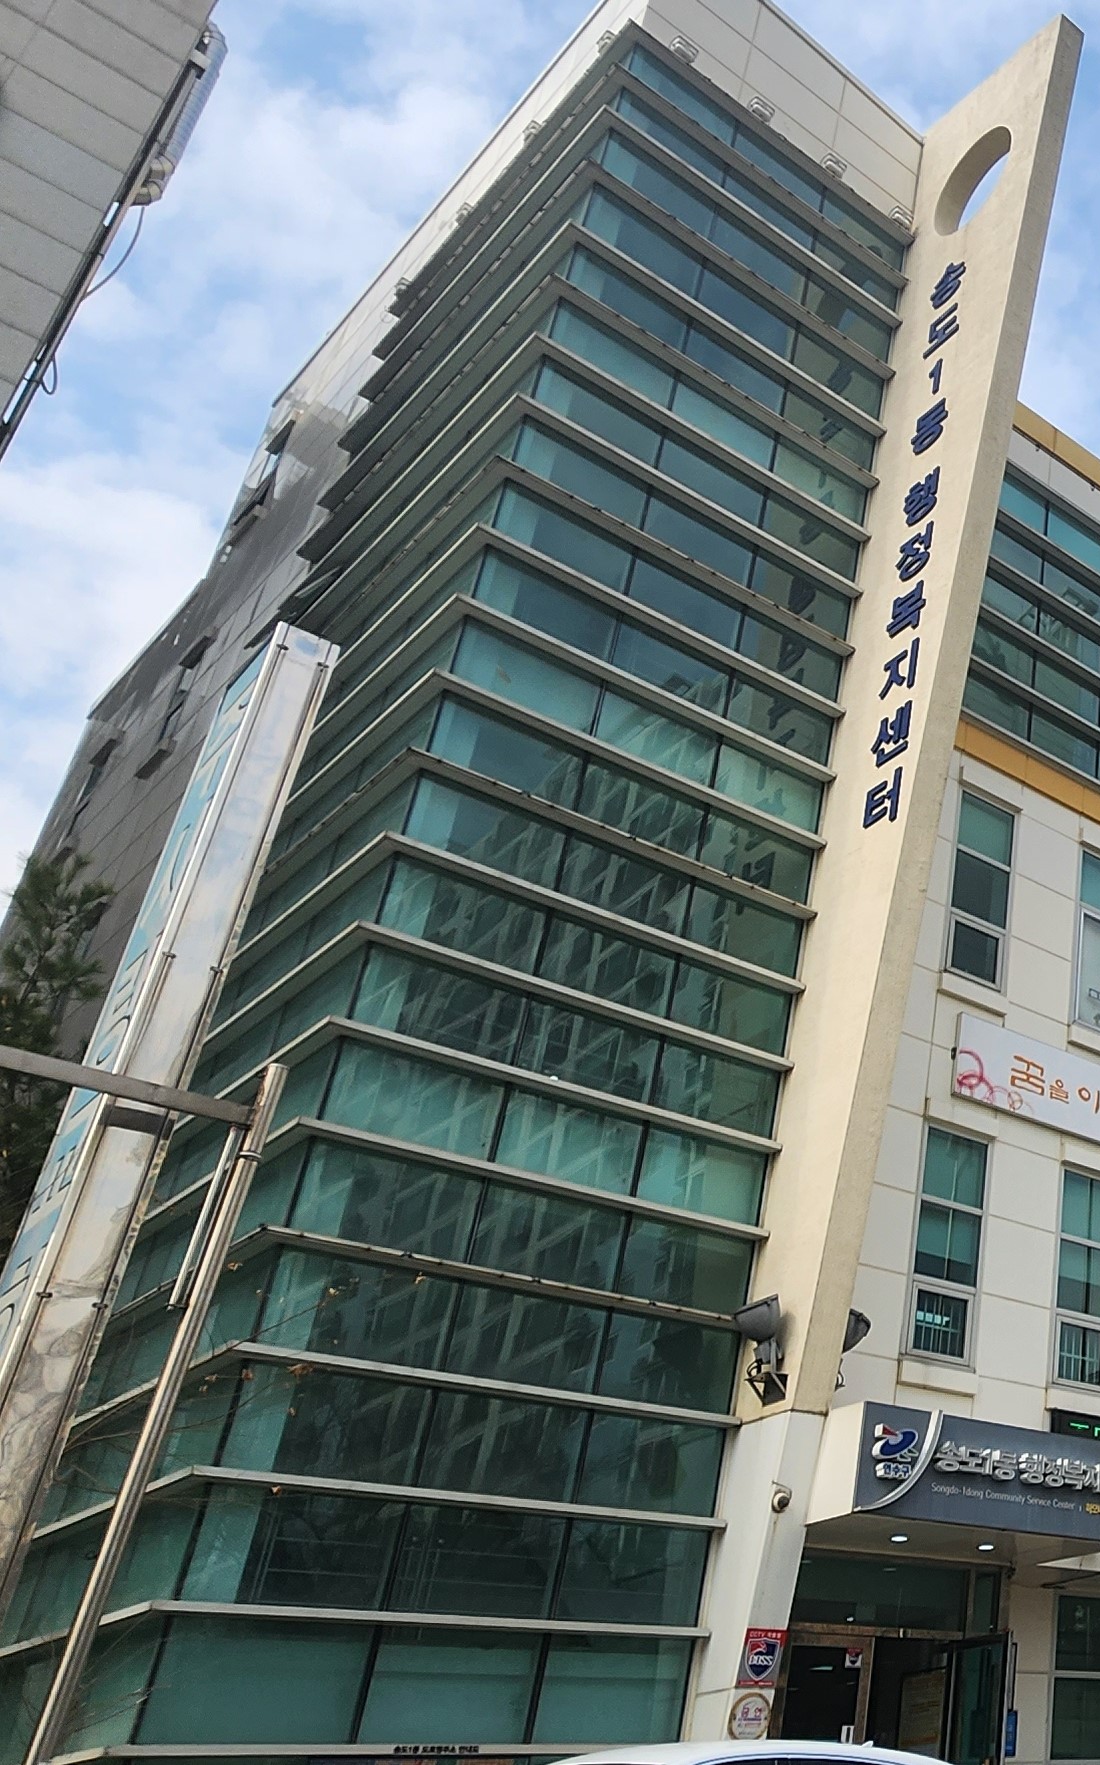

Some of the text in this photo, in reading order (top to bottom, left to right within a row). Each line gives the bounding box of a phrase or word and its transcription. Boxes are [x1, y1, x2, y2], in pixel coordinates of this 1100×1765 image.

[862, 261, 966, 830] 송도1동 행정복지센터
[1010, 1055, 1069, 1105] 꿈을
[879, 1462, 911, 1479] 연수구
[933, 1440, 1018, 1482] 송도1동
[931, 1482, 1076, 1511] Songdo-1dong Community Service Center
[750, 1630, 766, 1638] CCTV
